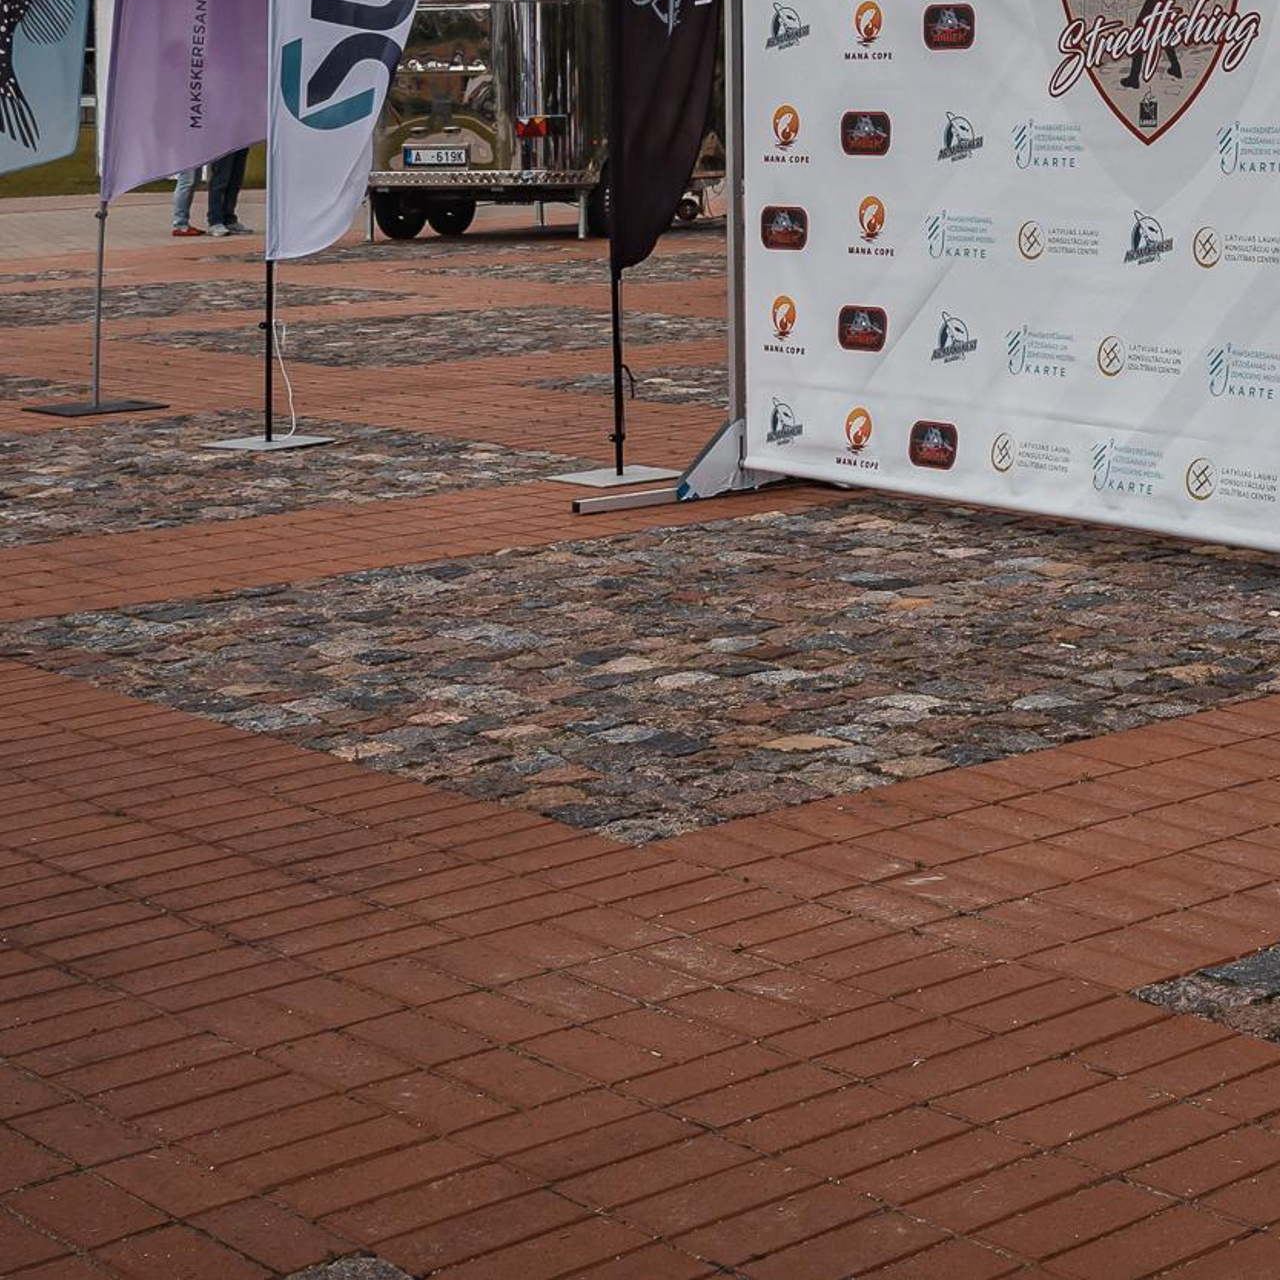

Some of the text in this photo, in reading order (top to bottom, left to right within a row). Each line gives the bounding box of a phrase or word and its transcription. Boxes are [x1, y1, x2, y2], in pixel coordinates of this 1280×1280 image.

[844, 52, 892, 60] MANA COPE
[764, 155, 810, 163] MANA COPE
[1033, 157, 1076, 168] KARTE
[848, 247, 895, 257] MANA COPE
[945, 246, 987, 259] KARTE
[1024, 365, 1066, 377] KARTE
[1228, 386, 1275, 400] KARTE
[836, 457, 879, 471] MANA COPE
[1108, 478, 1153, 495] KARTE
